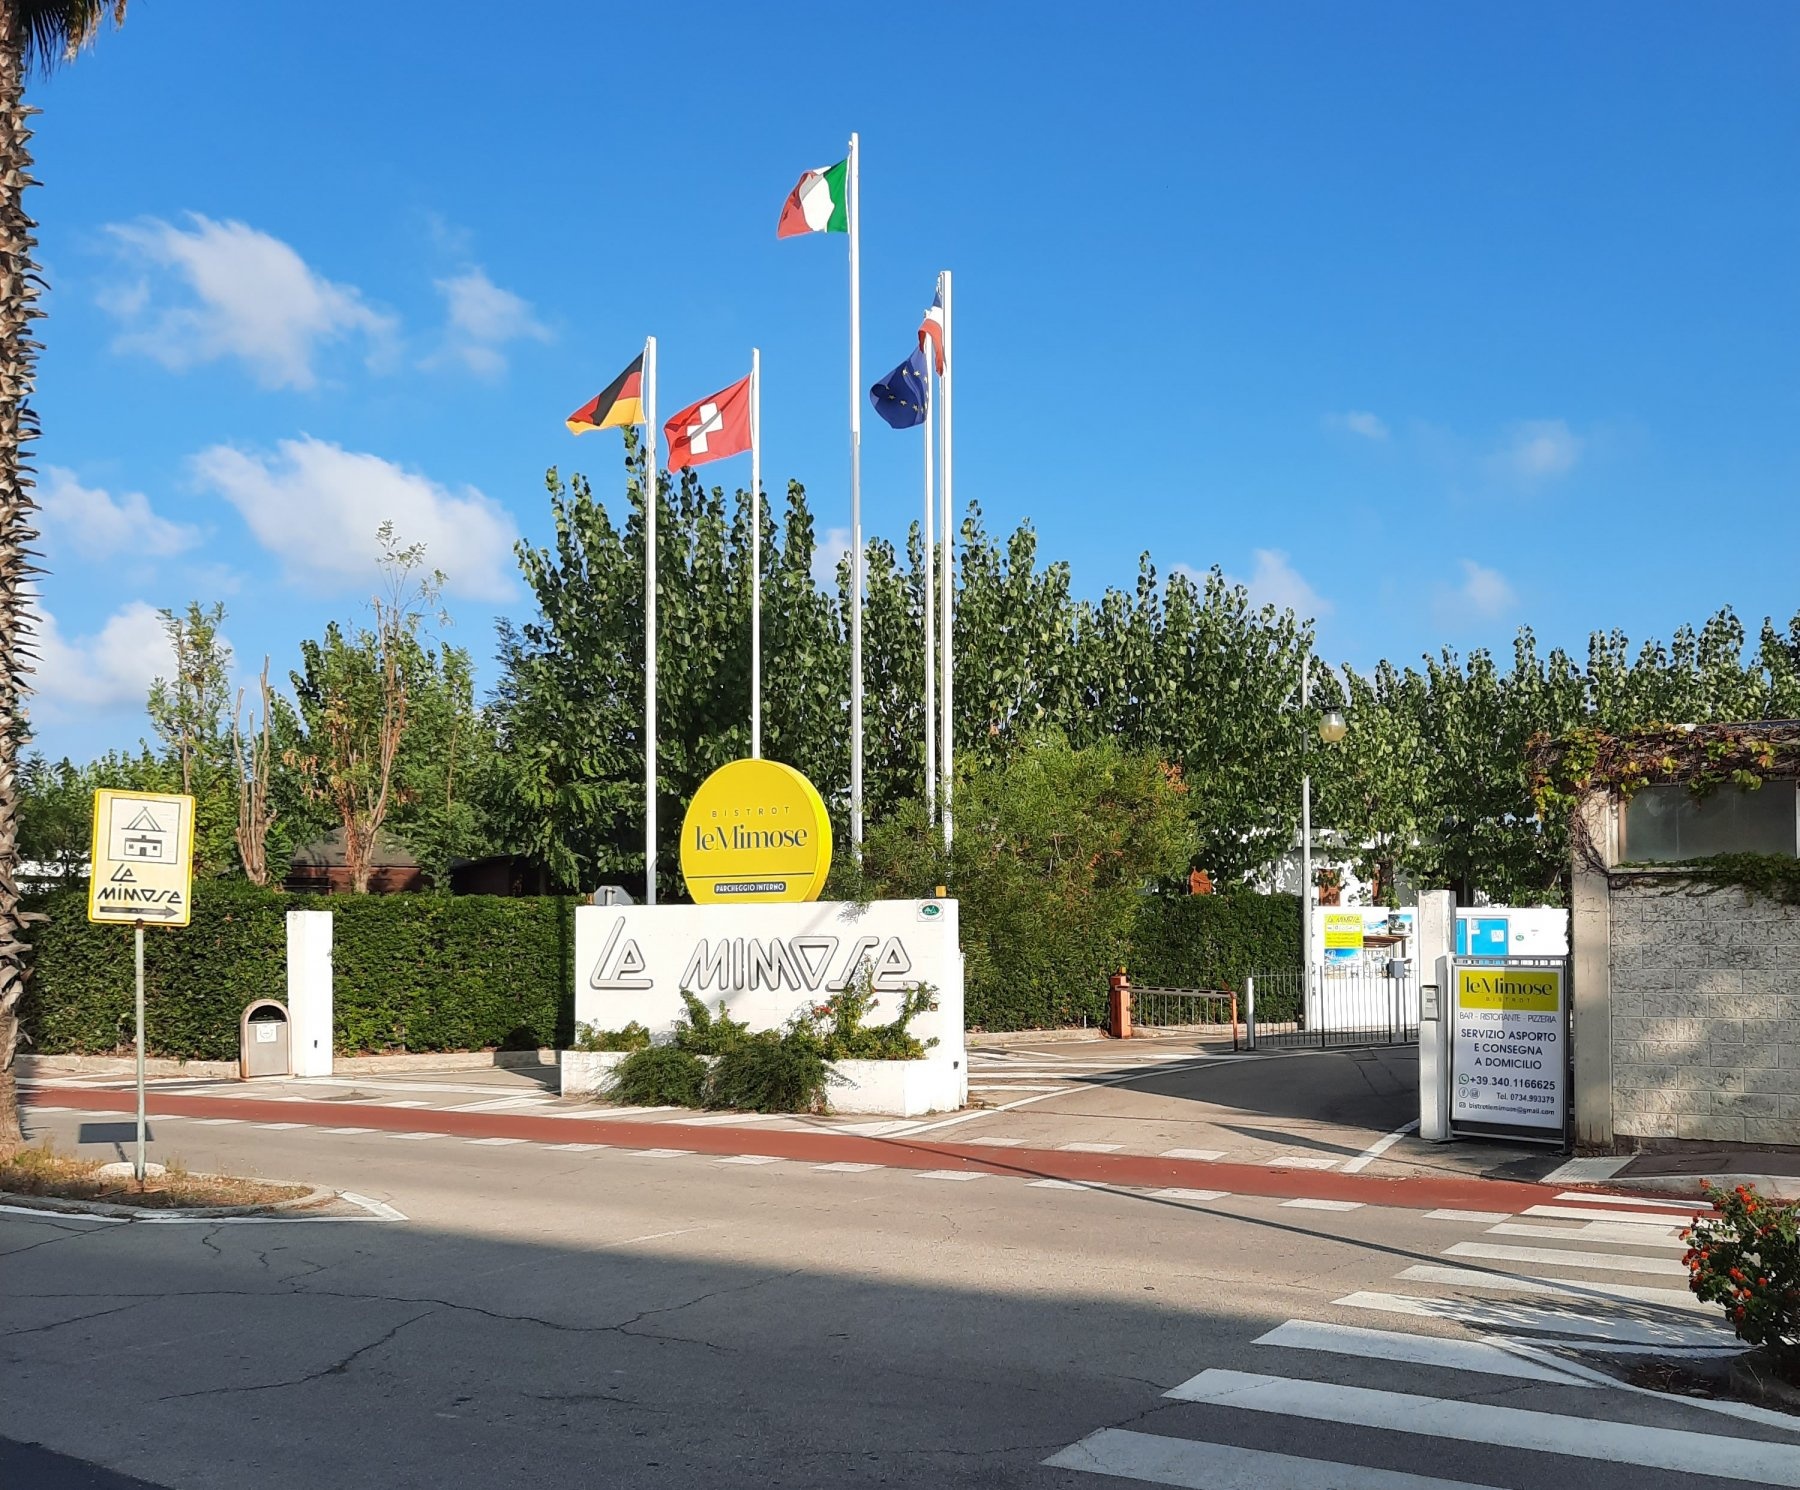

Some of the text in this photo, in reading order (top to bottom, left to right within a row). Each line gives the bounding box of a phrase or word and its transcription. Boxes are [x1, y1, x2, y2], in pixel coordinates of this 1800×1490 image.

[712, 806, 790, 817] BISTROT
[716, 883, 784, 892] PARCHEGGIO INTERNO
[1460, 1012, 1473, 1020] BAR
[1480, 1013, 1520, 1022] RISTORANTE
[1528, 1014, 1557, 1023] PIZZERIA
[1461, 1028, 1556, 1042] SERVIZIO ASPORTO
[1474, 1043, 1543, 1055] E CONSEGNA
[1474, 1057, 1542, 1070] A DOMICILIO
[1470, 1075, 1556, 1090] +39.340.1166625
[1496, 1092, 1508, 1100] Tel.
